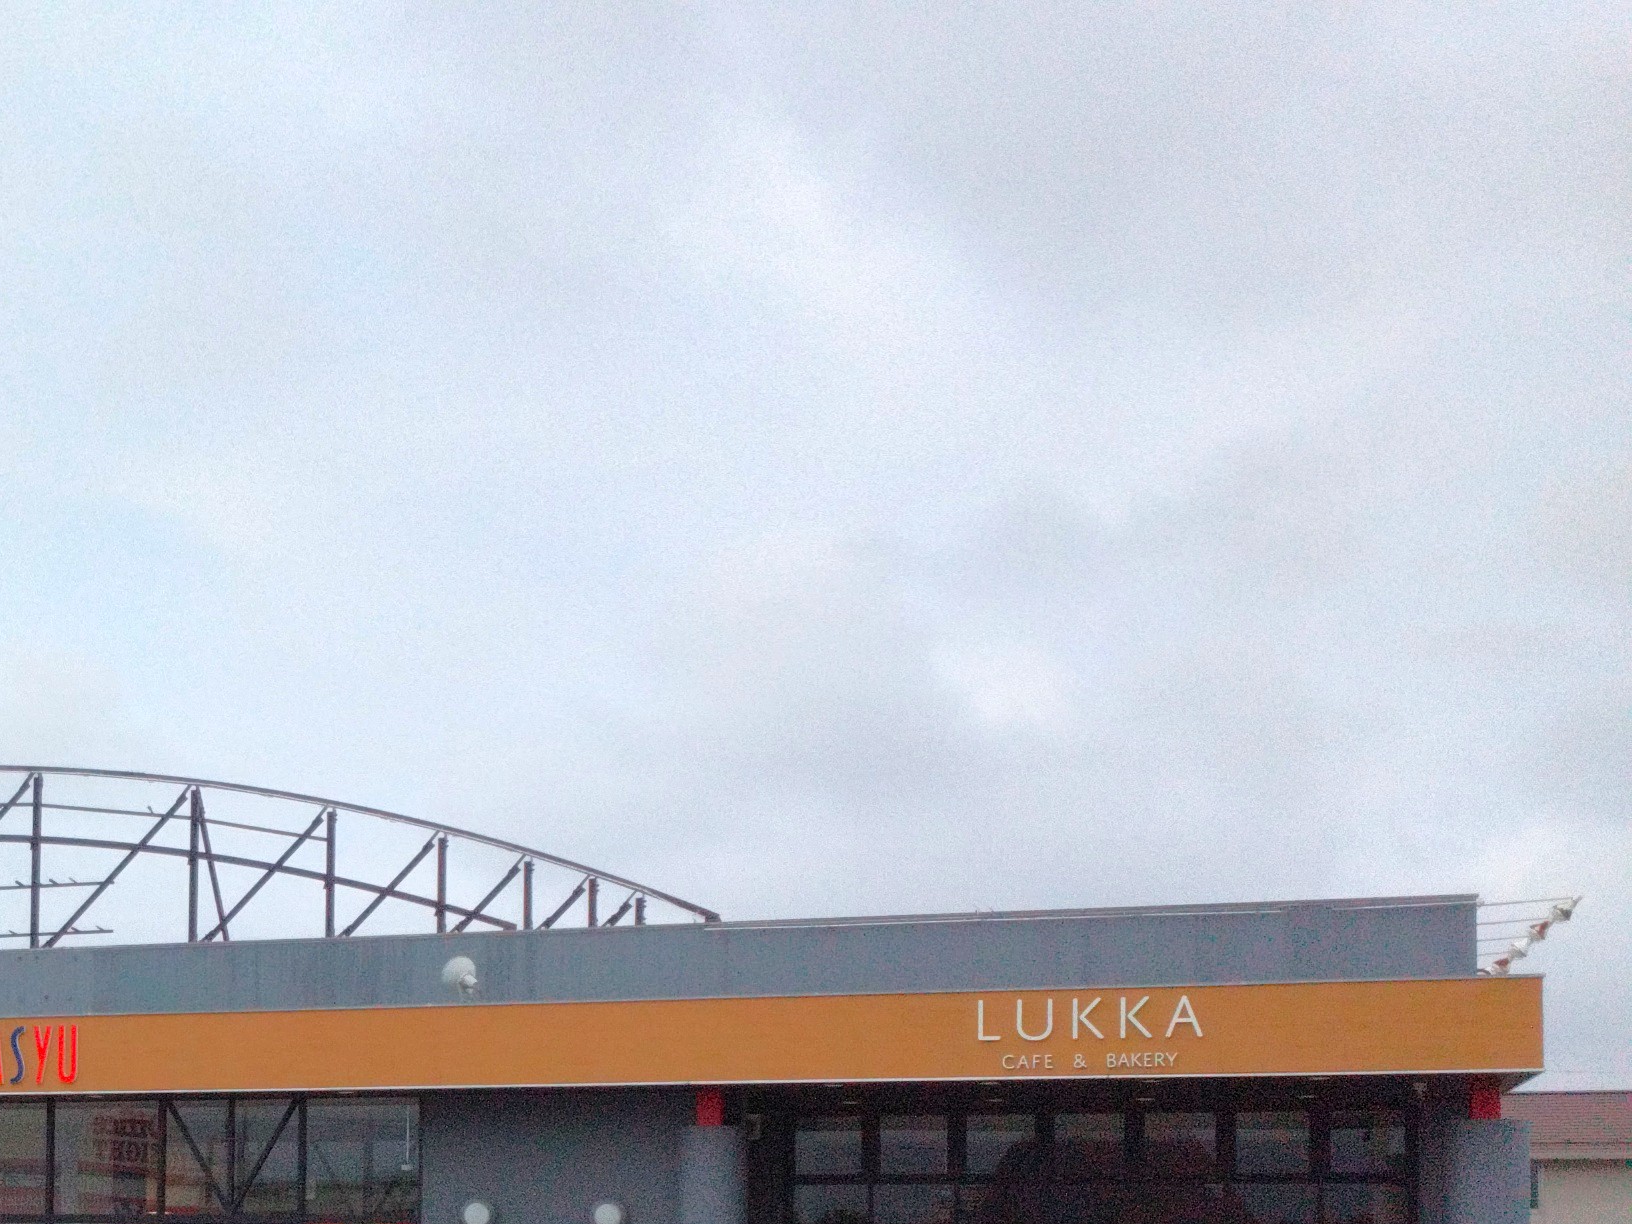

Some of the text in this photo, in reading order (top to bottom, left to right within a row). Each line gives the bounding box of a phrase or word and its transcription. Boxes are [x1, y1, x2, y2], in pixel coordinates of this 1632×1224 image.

[976, 994, 1204, 1042] LUKKA
[1001, 1051, 1178, 1070] CAFE & BAKERY
